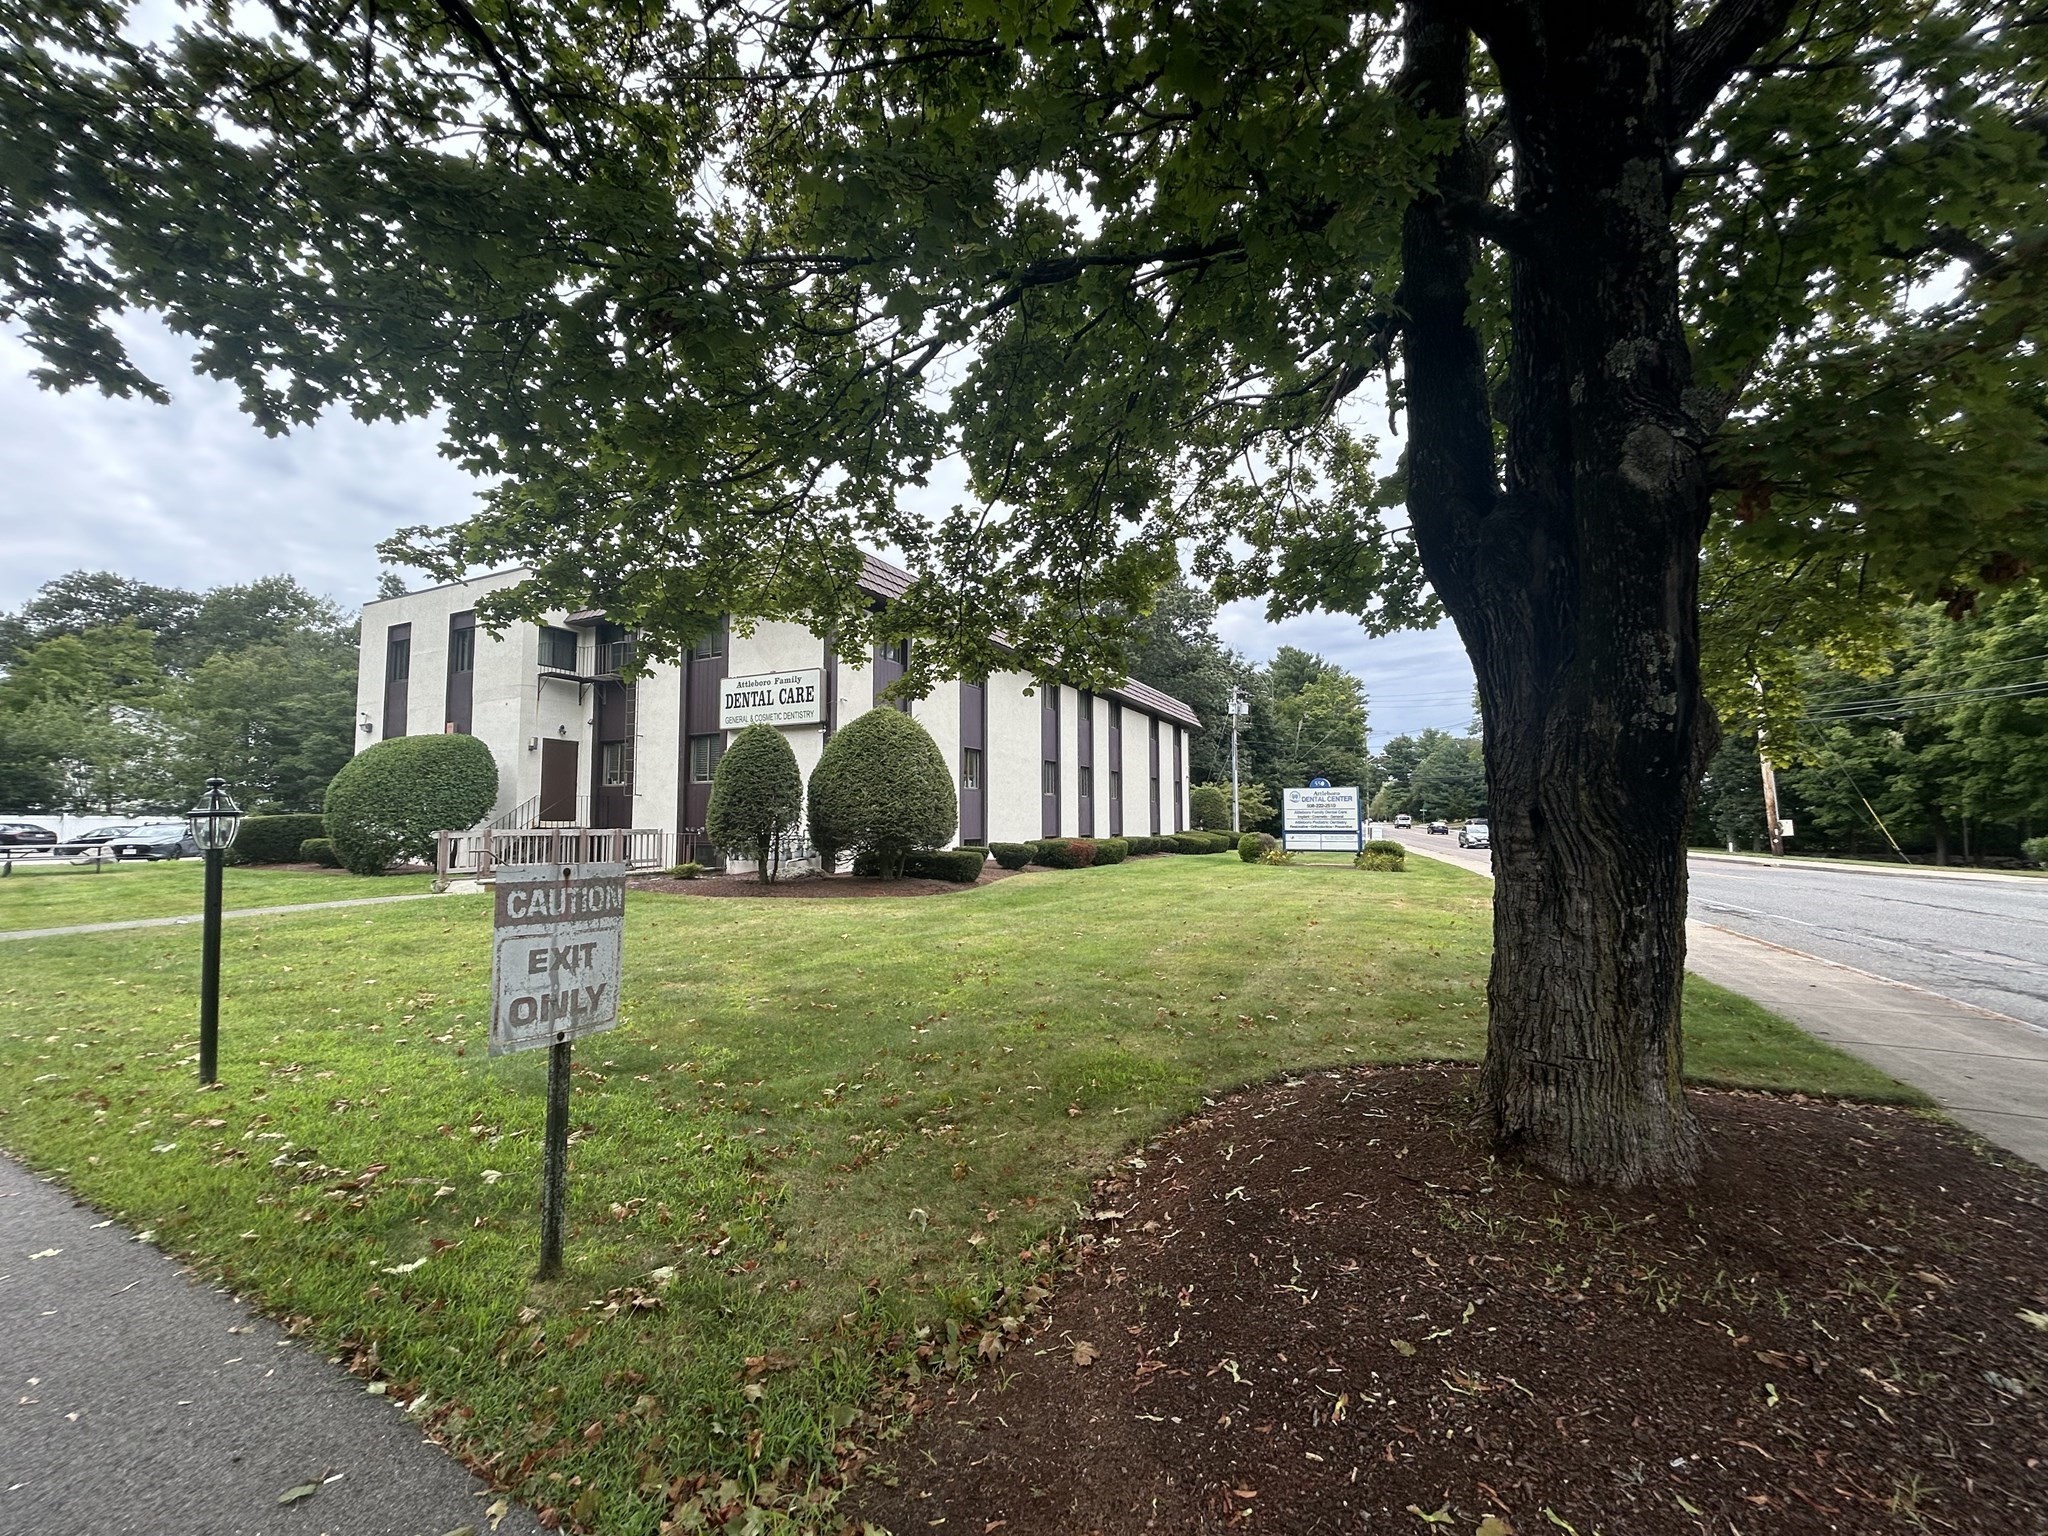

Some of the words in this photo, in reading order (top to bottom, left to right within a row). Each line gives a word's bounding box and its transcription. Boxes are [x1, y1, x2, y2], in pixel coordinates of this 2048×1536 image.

[736, 679, 771, 689] Attleboro
[774, 676, 802, 685] Family
[725, 690, 774, 709] DENTAL
[779, 685, 815, 705] CARE
[725, 714, 749, 724] GENERAL
[754, 712, 783, 723] COSMETIC
[783, 710, 815, 720] DENTISTRY
[507, 885, 622, 919] CAUTION
[528, 942, 597, 975] EXIT
[509, 983, 607, 1028] ONLY
